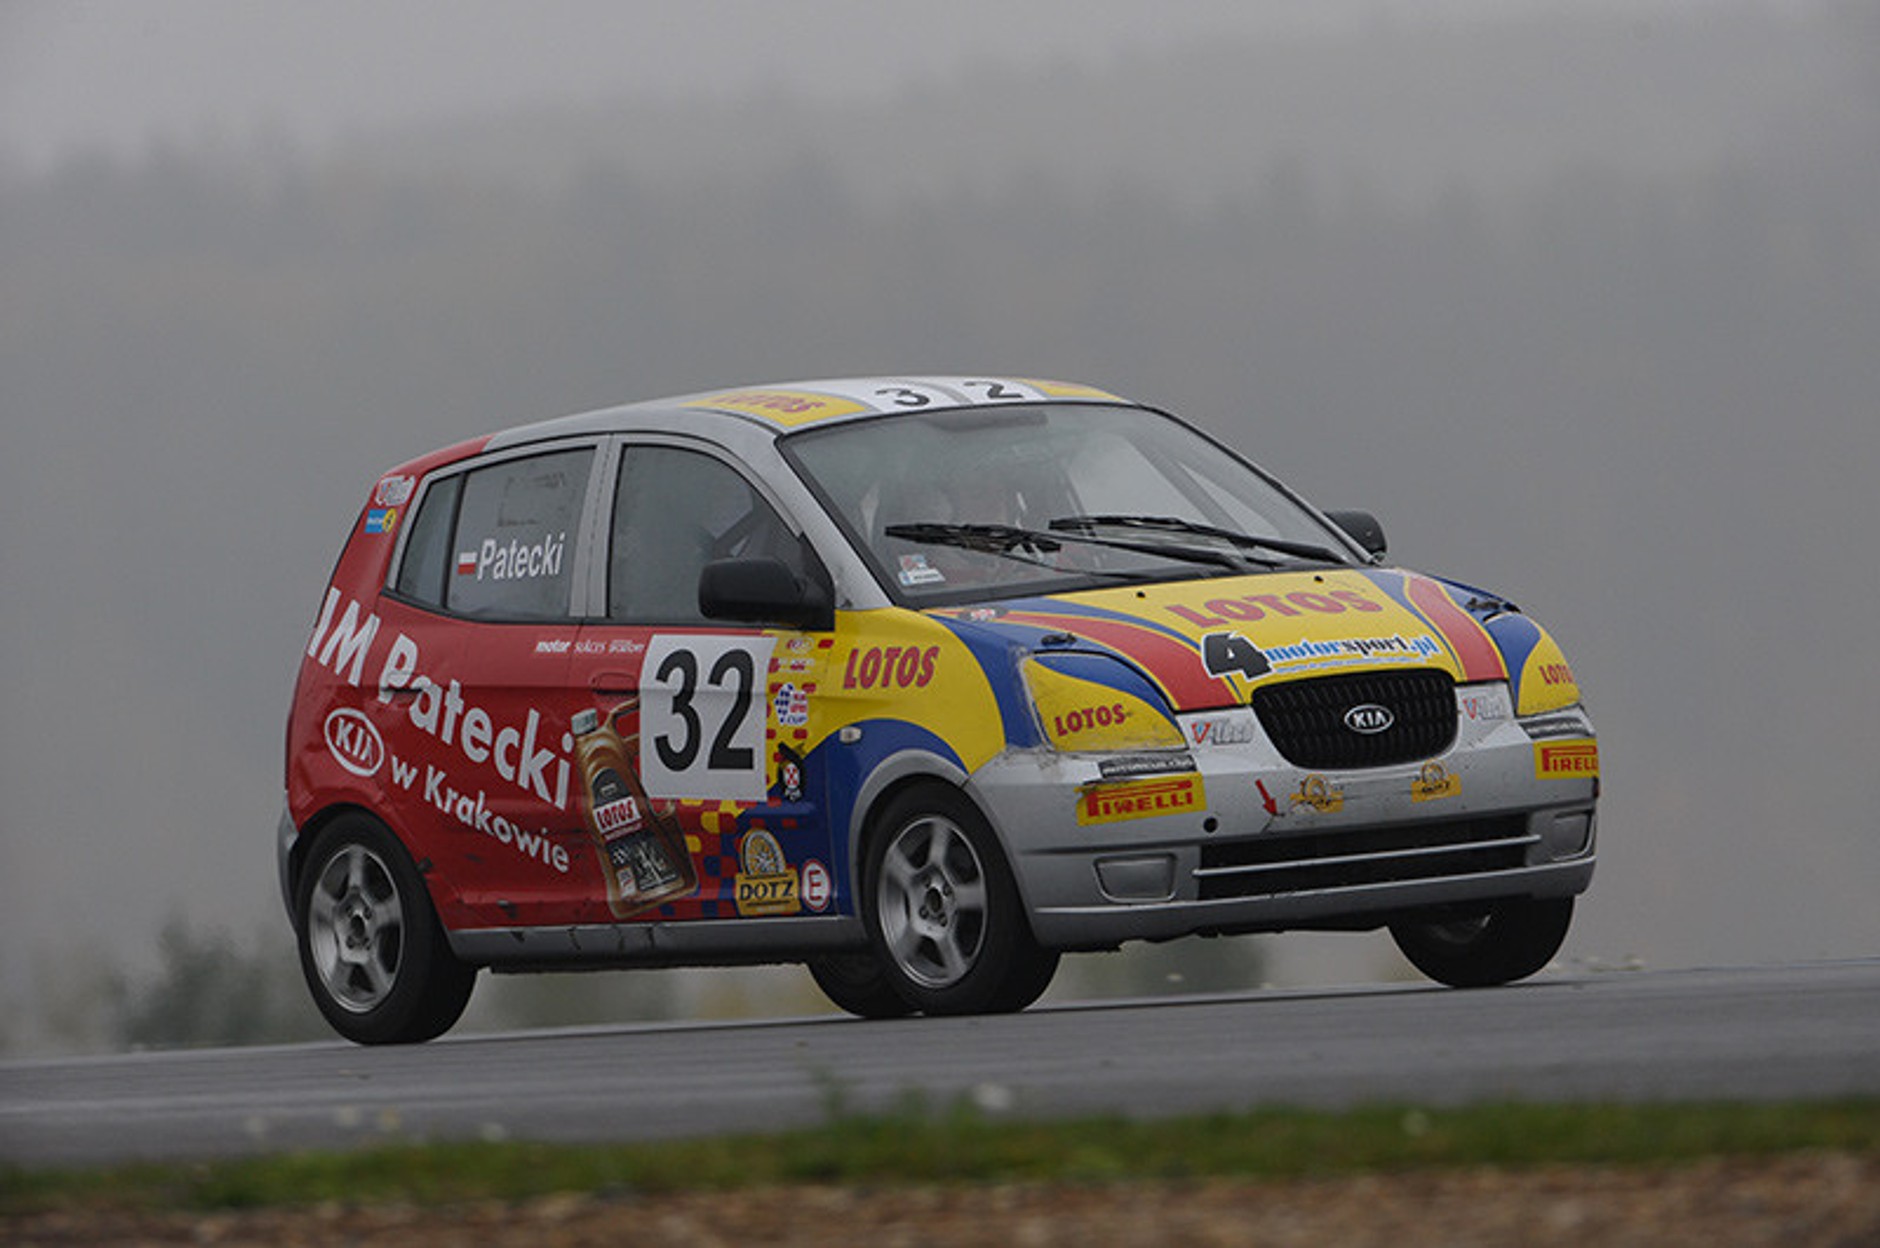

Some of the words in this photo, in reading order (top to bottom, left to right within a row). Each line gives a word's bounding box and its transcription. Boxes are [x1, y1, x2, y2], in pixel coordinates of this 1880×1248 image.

[477, 532, 566, 580] Patecki
[1164, 589, 1383, 628] LOTOS
[843, 645, 940, 689] LOTOS
[1538, 663, 1573, 685] LOTO
[377, 632, 574, 811] Patecki
[653, 648, 755, 771] 32
[1054, 703, 1126, 737] LOTOS
[1353, 711, 1387, 727] KIA
[335, 716, 374, 767] KIA
[391, 755, 418, 790] w
[424, 764, 570, 872] Krakowie
[597, 800, 635, 829] LOTOS
[1085, 780, 1193, 818] PIRELLI
[740, 880, 793, 901] DOTZ
